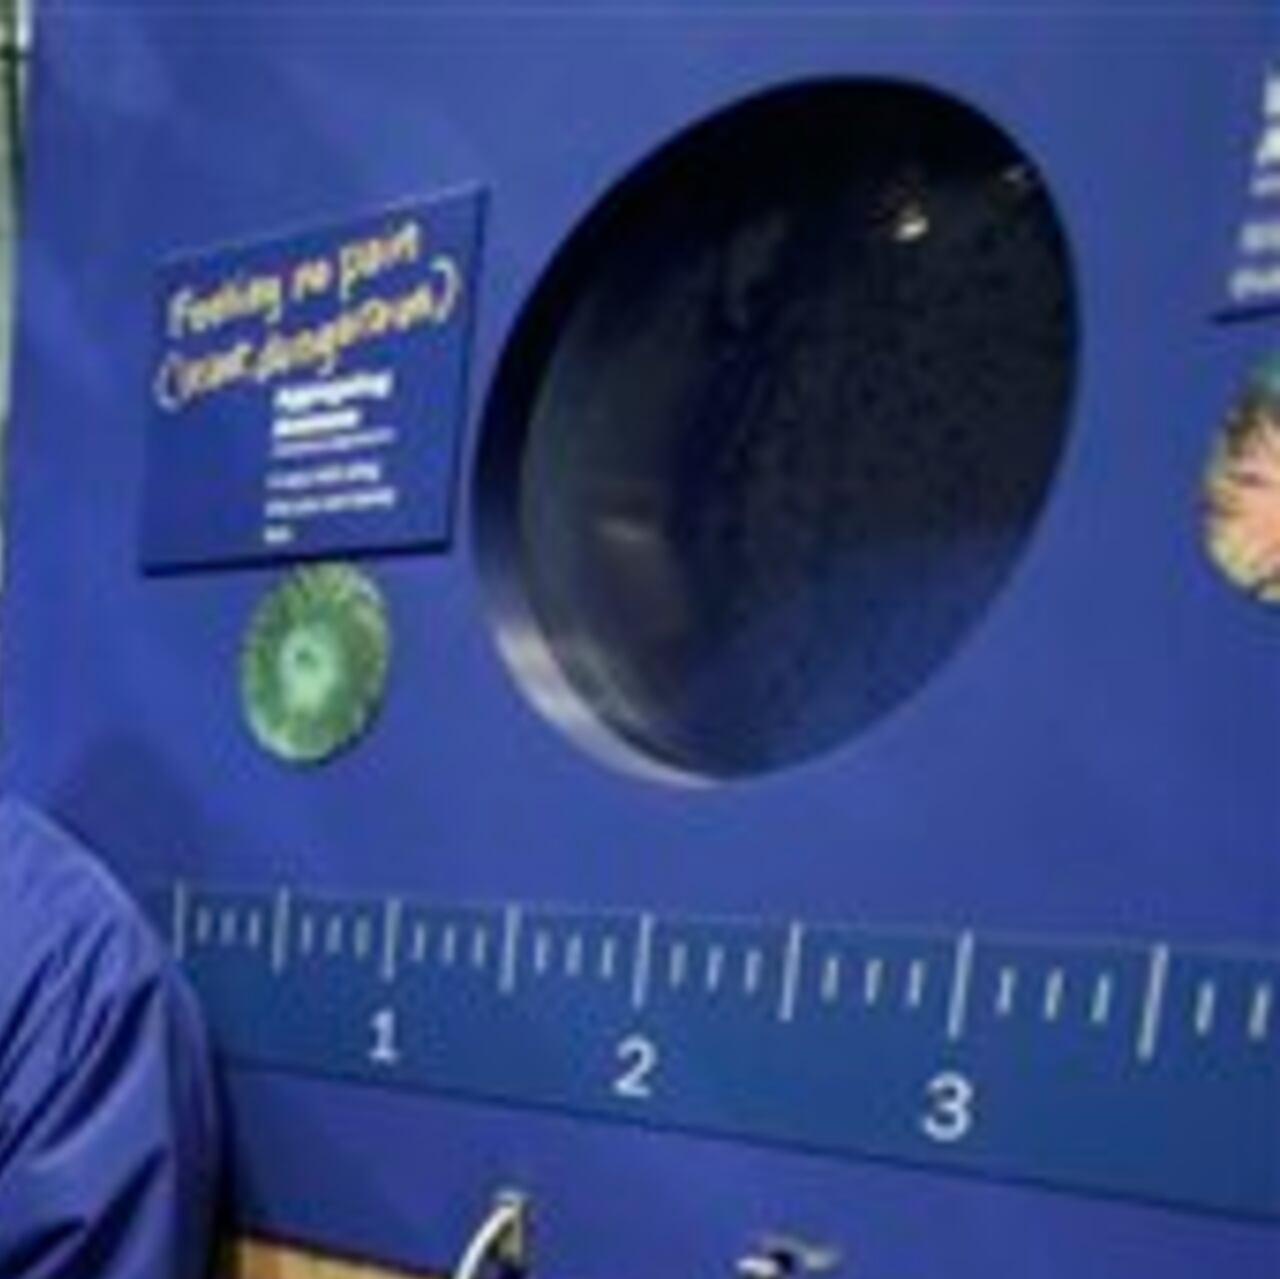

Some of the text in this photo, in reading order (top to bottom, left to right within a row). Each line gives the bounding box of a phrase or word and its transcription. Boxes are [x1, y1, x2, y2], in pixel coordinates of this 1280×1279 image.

[292, 258, 333, 302] no
[367, 1008, 974, 1142] 1 2 3
